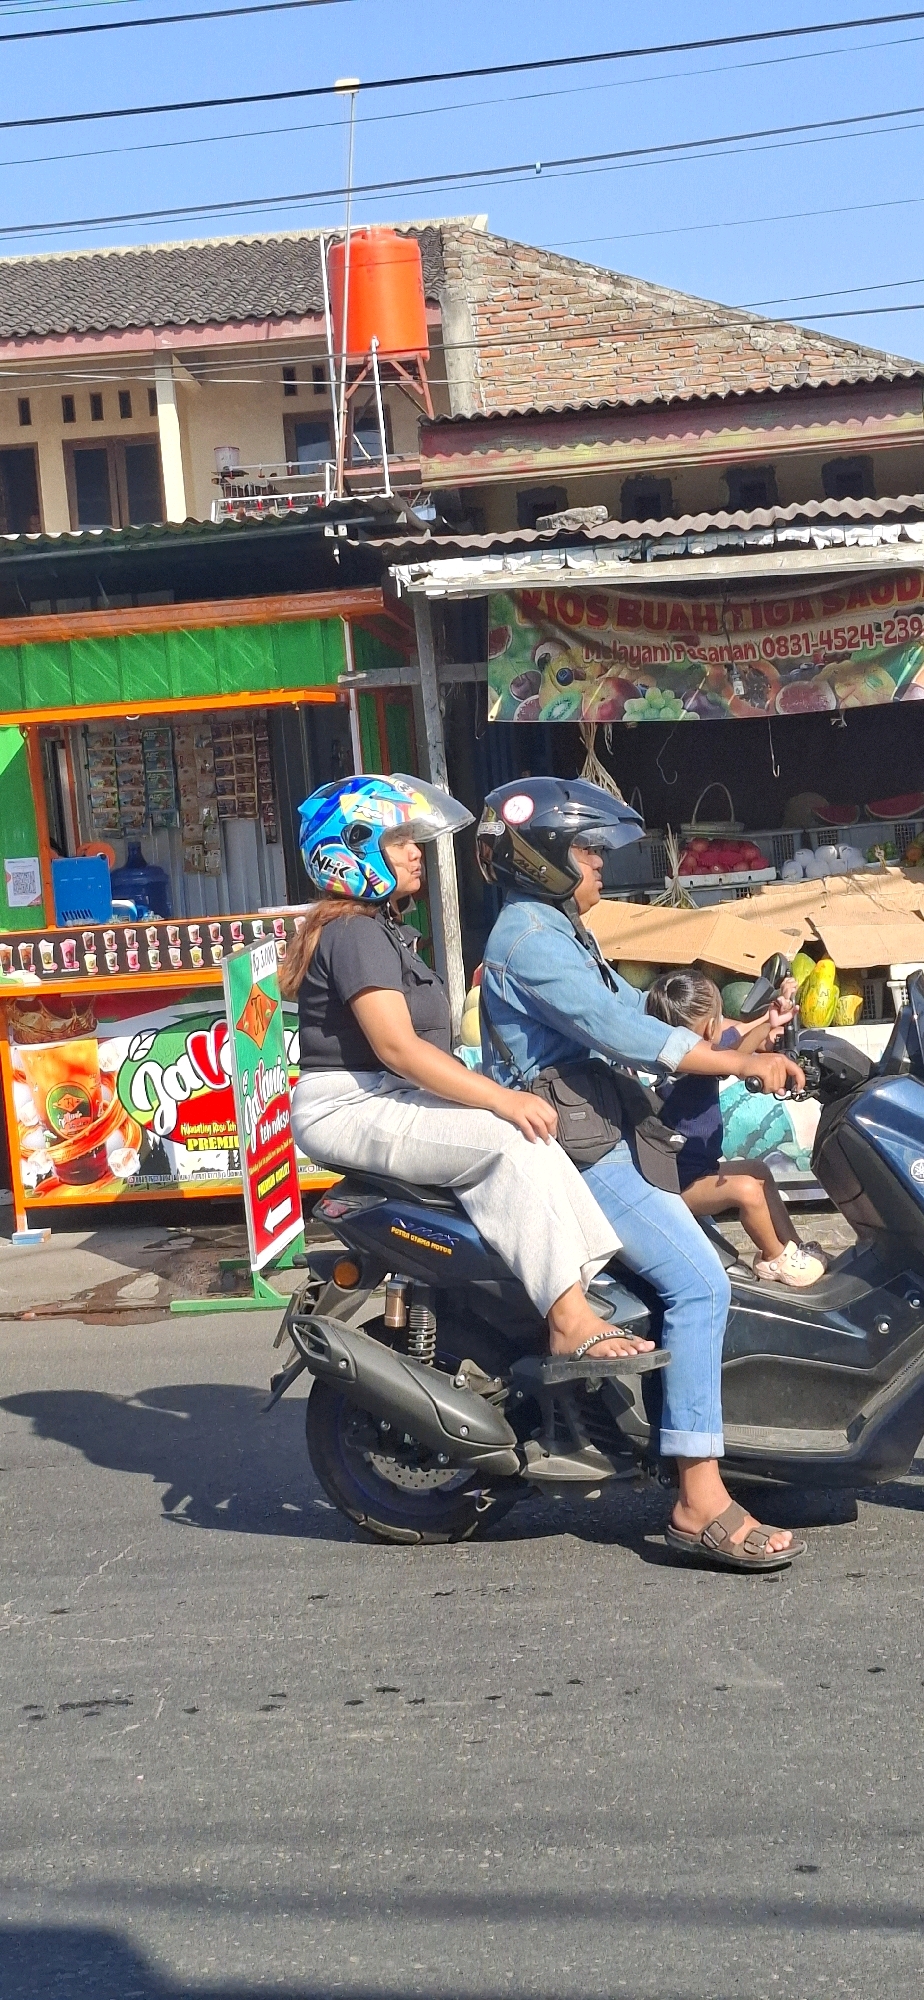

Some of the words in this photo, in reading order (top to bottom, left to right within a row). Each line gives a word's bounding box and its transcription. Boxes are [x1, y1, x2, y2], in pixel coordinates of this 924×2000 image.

[521, 590, 609, 627] KIOS
[616, 598, 718, 634] BUAH
[722, 598, 817, 632] TIGA
[584, 640, 669, 668] Melayani
[674, 642, 757, 664] Pesanan
[311, 845, 355, 881] NHK
[430, 1242, 453, 1255] MOTOR
